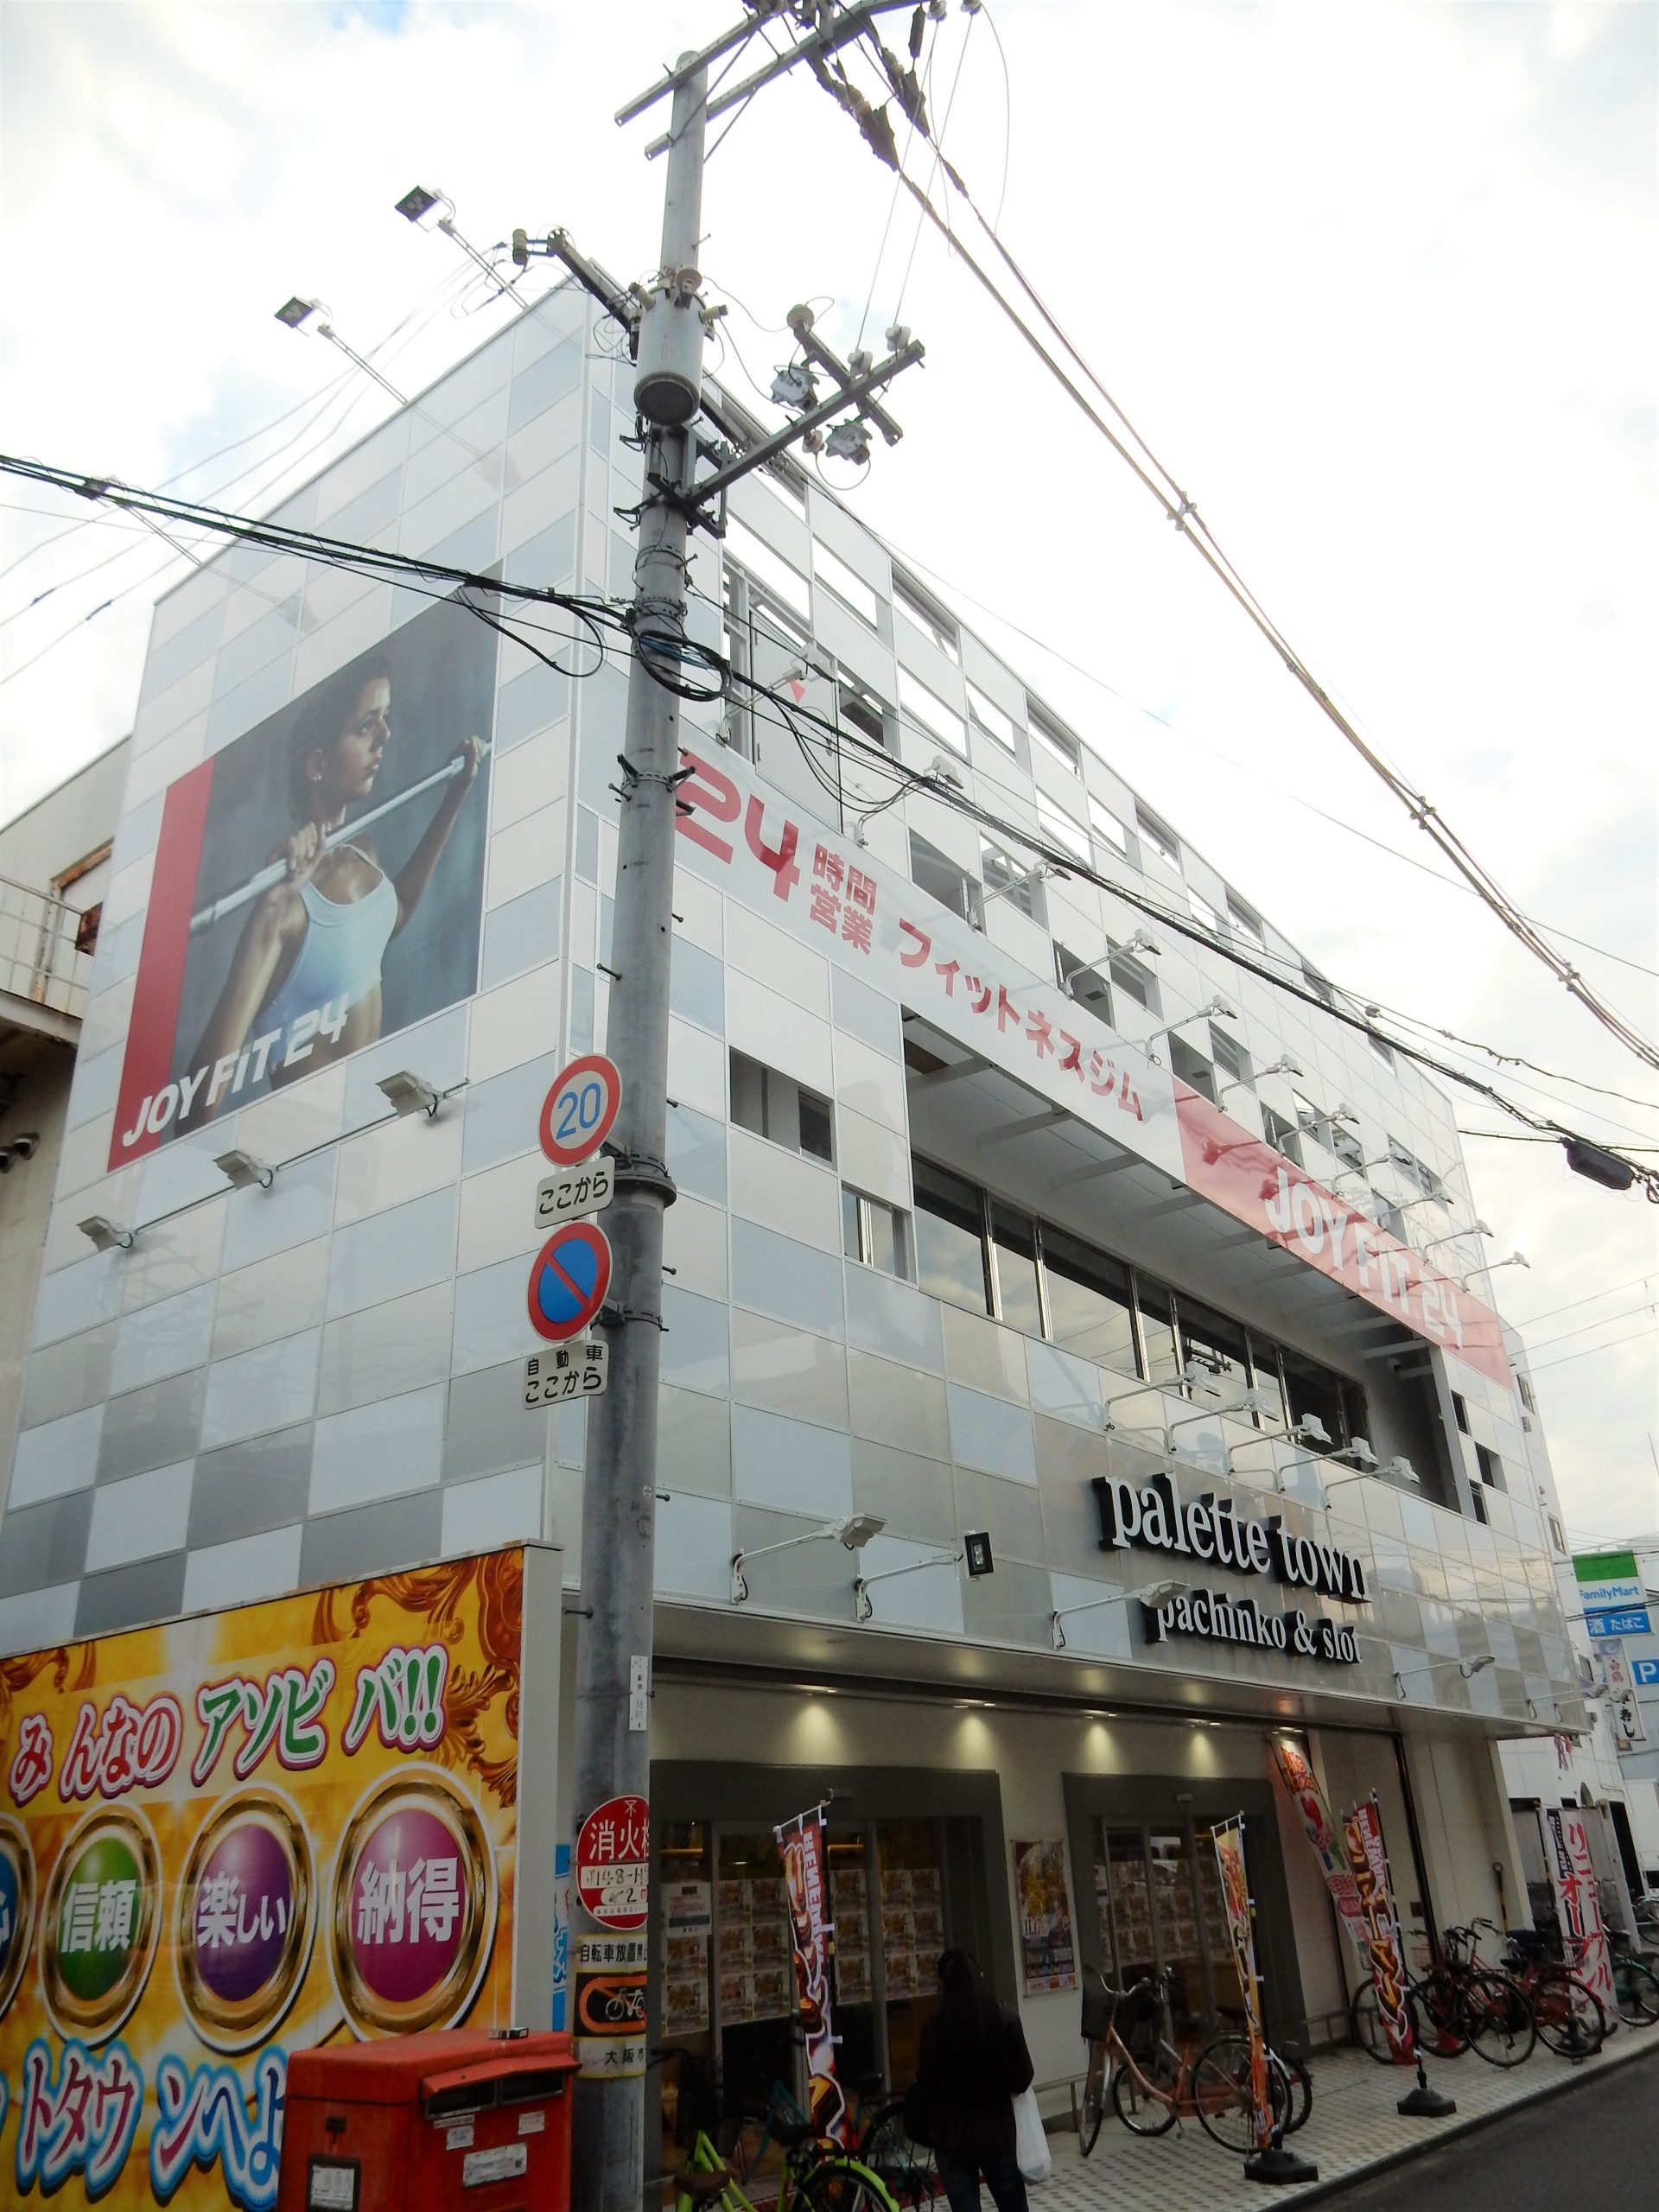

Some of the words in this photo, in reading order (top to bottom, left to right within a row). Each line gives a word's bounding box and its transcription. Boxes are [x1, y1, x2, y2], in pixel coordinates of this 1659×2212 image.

[674, 747, 800, 902] 24
[812, 842, 878, 915] 時間
[809, 883, 874, 955] 営業
[899, 918, 1144, 1122] フィットネスジム
[555, 1082, 602, 1141] 20
[538, 1171, 609, 1215] ここから
[524, 1365, 603, 1404] ここから
[527, 1344, 604, 1376] 自動車
[1099, 1471, 1272, 1575] palette
[1274, 1515, 1373, 1603] town
[1152, 1588, 1287, 1649] pachinko
[1292, 1609, 1319, 1656] &
[1322, 1618, 1363, 1664] slot
[1587, 1618, 1605, 1635] 酒
[1610, 1617, 1645, 1632] たばこ
[1637, 1662, 1657, 1684] P
[60, 1878, 137, 1954] 信頼
[195, 1868, 288, 1950] 楽しい
[358, 1856, 461, 1946] 納得
